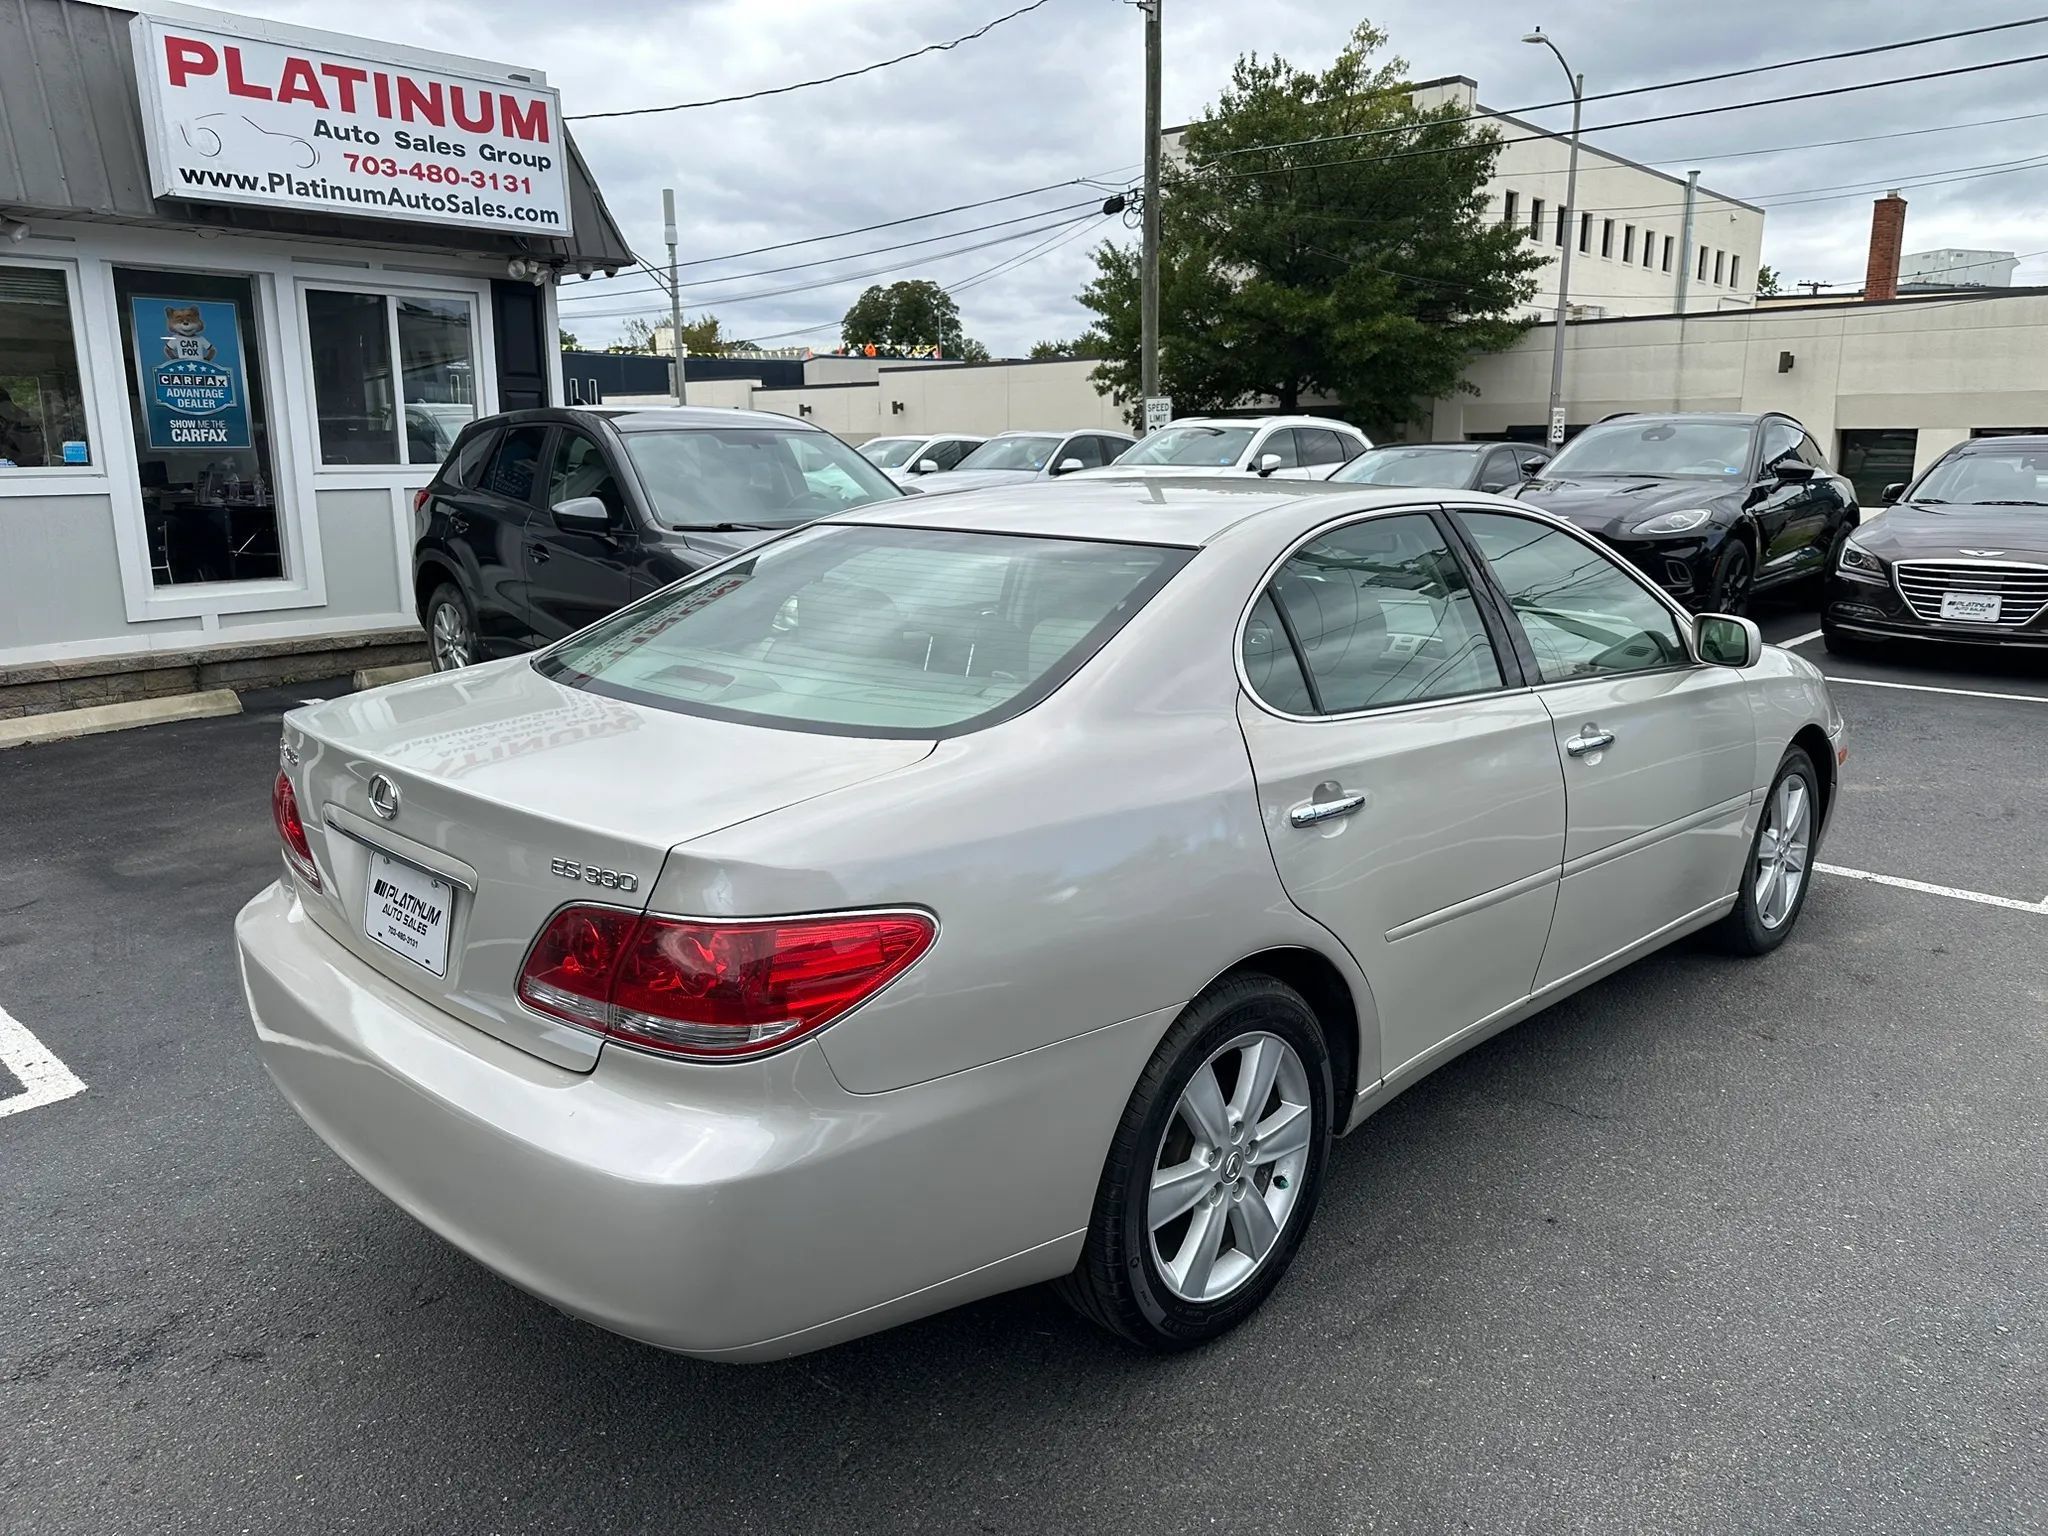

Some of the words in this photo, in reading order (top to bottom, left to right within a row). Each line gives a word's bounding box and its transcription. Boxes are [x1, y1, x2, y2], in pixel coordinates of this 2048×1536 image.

[164, 35, 550, 144] PLATINUM
[313, 119, 380, 145] Auto
[394, 130, 466, 157] Sales
[479, 143, 552, 171] Group
[343, 152, 531, 194] 703-480-3131
[179, 167, 559, 224] www.PlatinumAutoSales.com
[180, 340, 198, 348] CAR
[182, 348, 199, 356] FOX
[160, 375, 227, 387] CARFAX
[167, 388, 224, 398] ADVANTAGE
[177, 399, 216, 409] DEALER
[1147, 403, 1169, 412] SPEED
[170, 420, 196, 428] SHOW
[197, 420, 210, 428] ME
[211, 420, 226, 428] THE
[1150, 414, 1168, 422] LIMIT
[171, 429, 227, 442] CARFAX
[1553, 425, 1563, 439] 25
[551, 856, 581, 880] ES
[584, 865, 638, 892] 330
[385, 884, 442, 926] PLATINUM
[382, 903, 403, 922] AUTO
[402, 914, 428, 936] SALES
